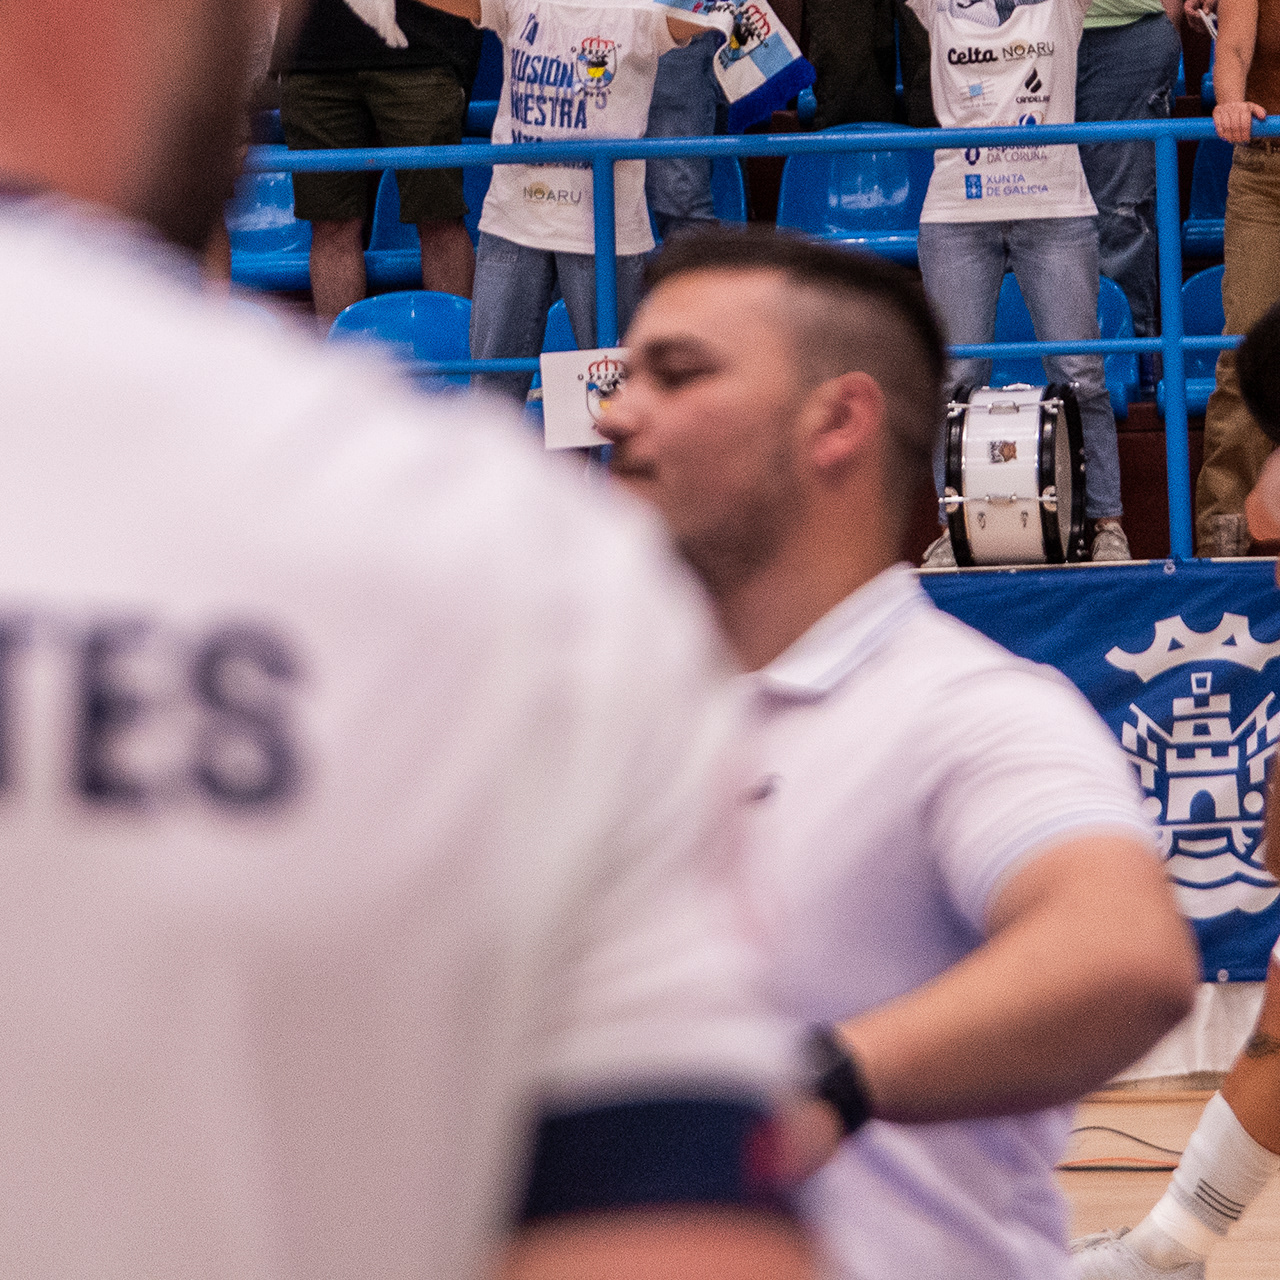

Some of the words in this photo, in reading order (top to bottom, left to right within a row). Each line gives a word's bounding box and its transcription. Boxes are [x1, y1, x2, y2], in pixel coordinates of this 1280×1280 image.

[947, 47, 999, 65] Celta
[1002, 41, 1056, 60] NOARU
[523, 185, 582, 205] NOARU
[986, 185, 1001, 197] DE
[1003, 183, 1050, 197] GALICIA
